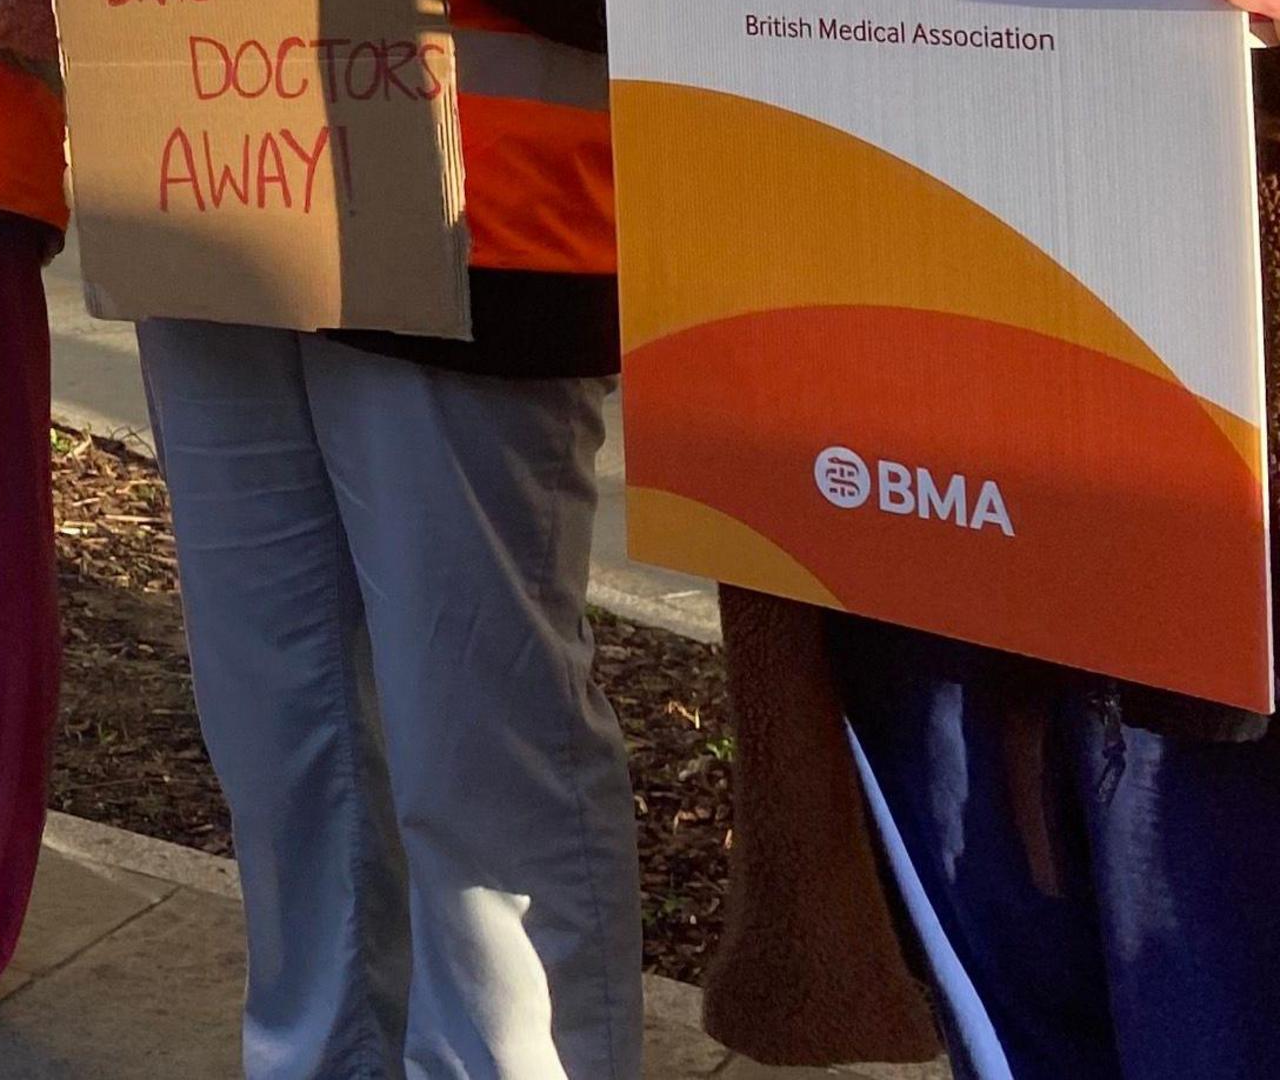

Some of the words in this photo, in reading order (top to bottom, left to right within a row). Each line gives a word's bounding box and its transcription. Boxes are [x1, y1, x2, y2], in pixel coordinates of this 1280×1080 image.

[188, 34, 446, 103] DOCTORS
[745, 14, 812, 40] British
[819, 18, 906, 45] Medical
[912, 23, 1056, 52] Association
[158, 125, 357, 217] AWAY!
[877, 458, 1016, 538] BMA
